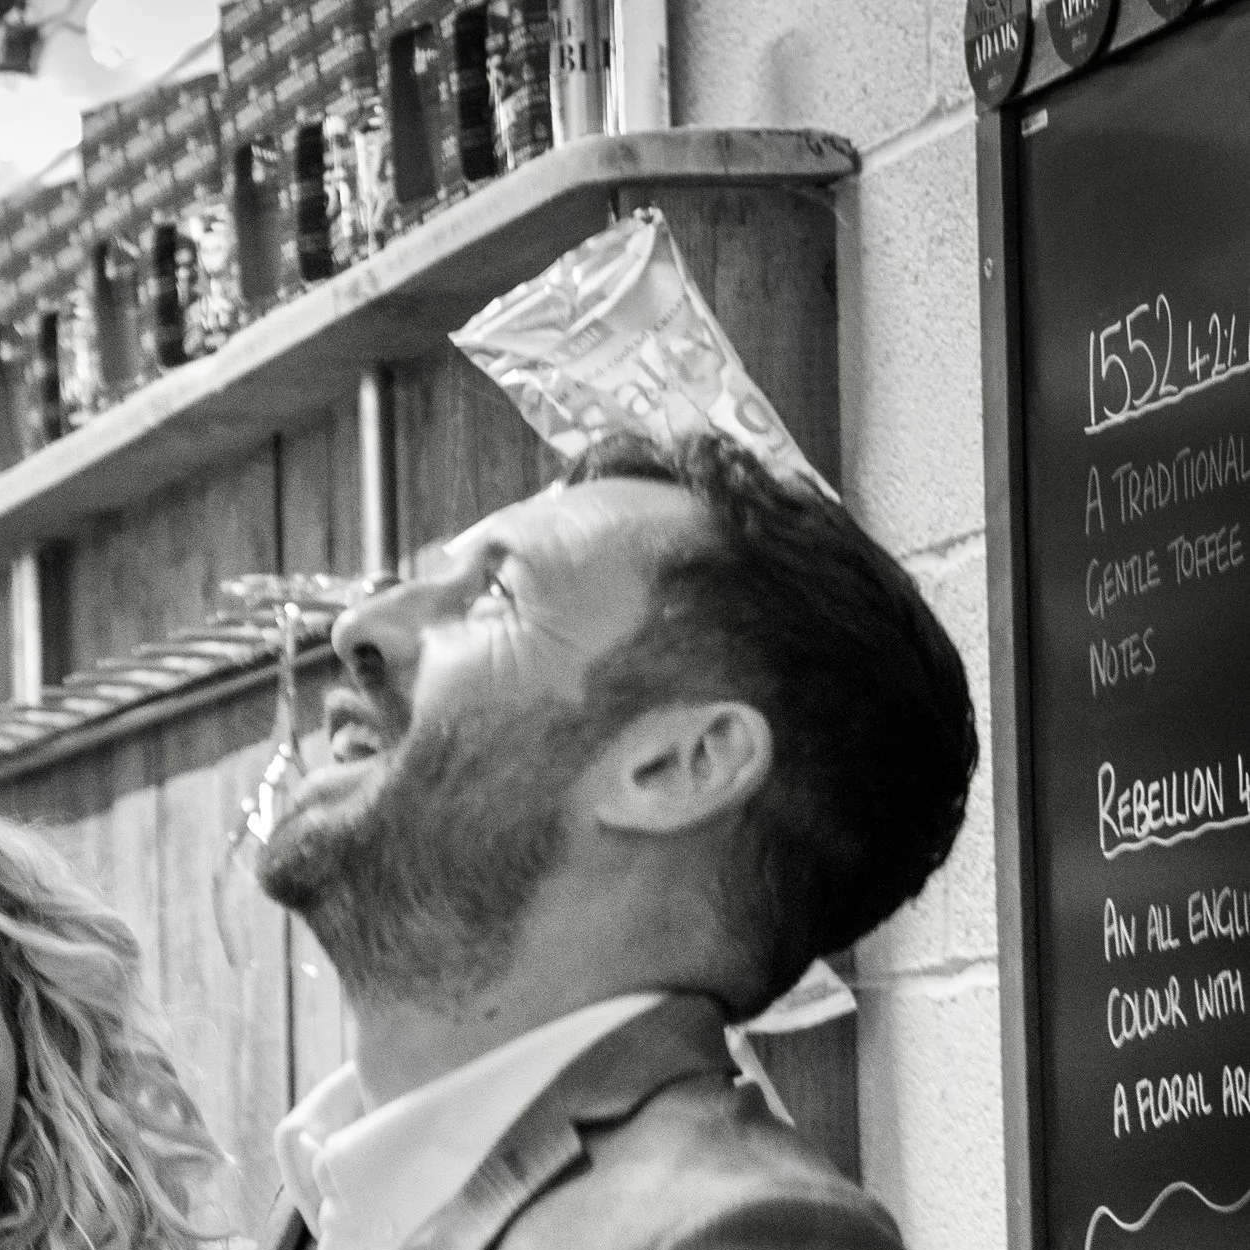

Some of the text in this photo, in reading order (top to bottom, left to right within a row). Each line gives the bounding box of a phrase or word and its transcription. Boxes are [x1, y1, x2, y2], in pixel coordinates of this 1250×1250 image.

[1089, 293, 1179, 426] 1552
[1085, 433, 1250, 535] A TRADITIONAL
[1085, 522, 1244, 620] GENTLE TOFFEE
[1089, 626, 1156, 702] NOTES
[1098, 761, 1224, 853] REBELLION
[1104, 896, 1137, 963] AN
[1147, 903, 1181, 953] ALL
[1107, 968, 1246, 1049] COLOUR WITH
[1113, 1082, 1131, 1139] A
[1135, 1071, 1213, 1129] FLORAL
